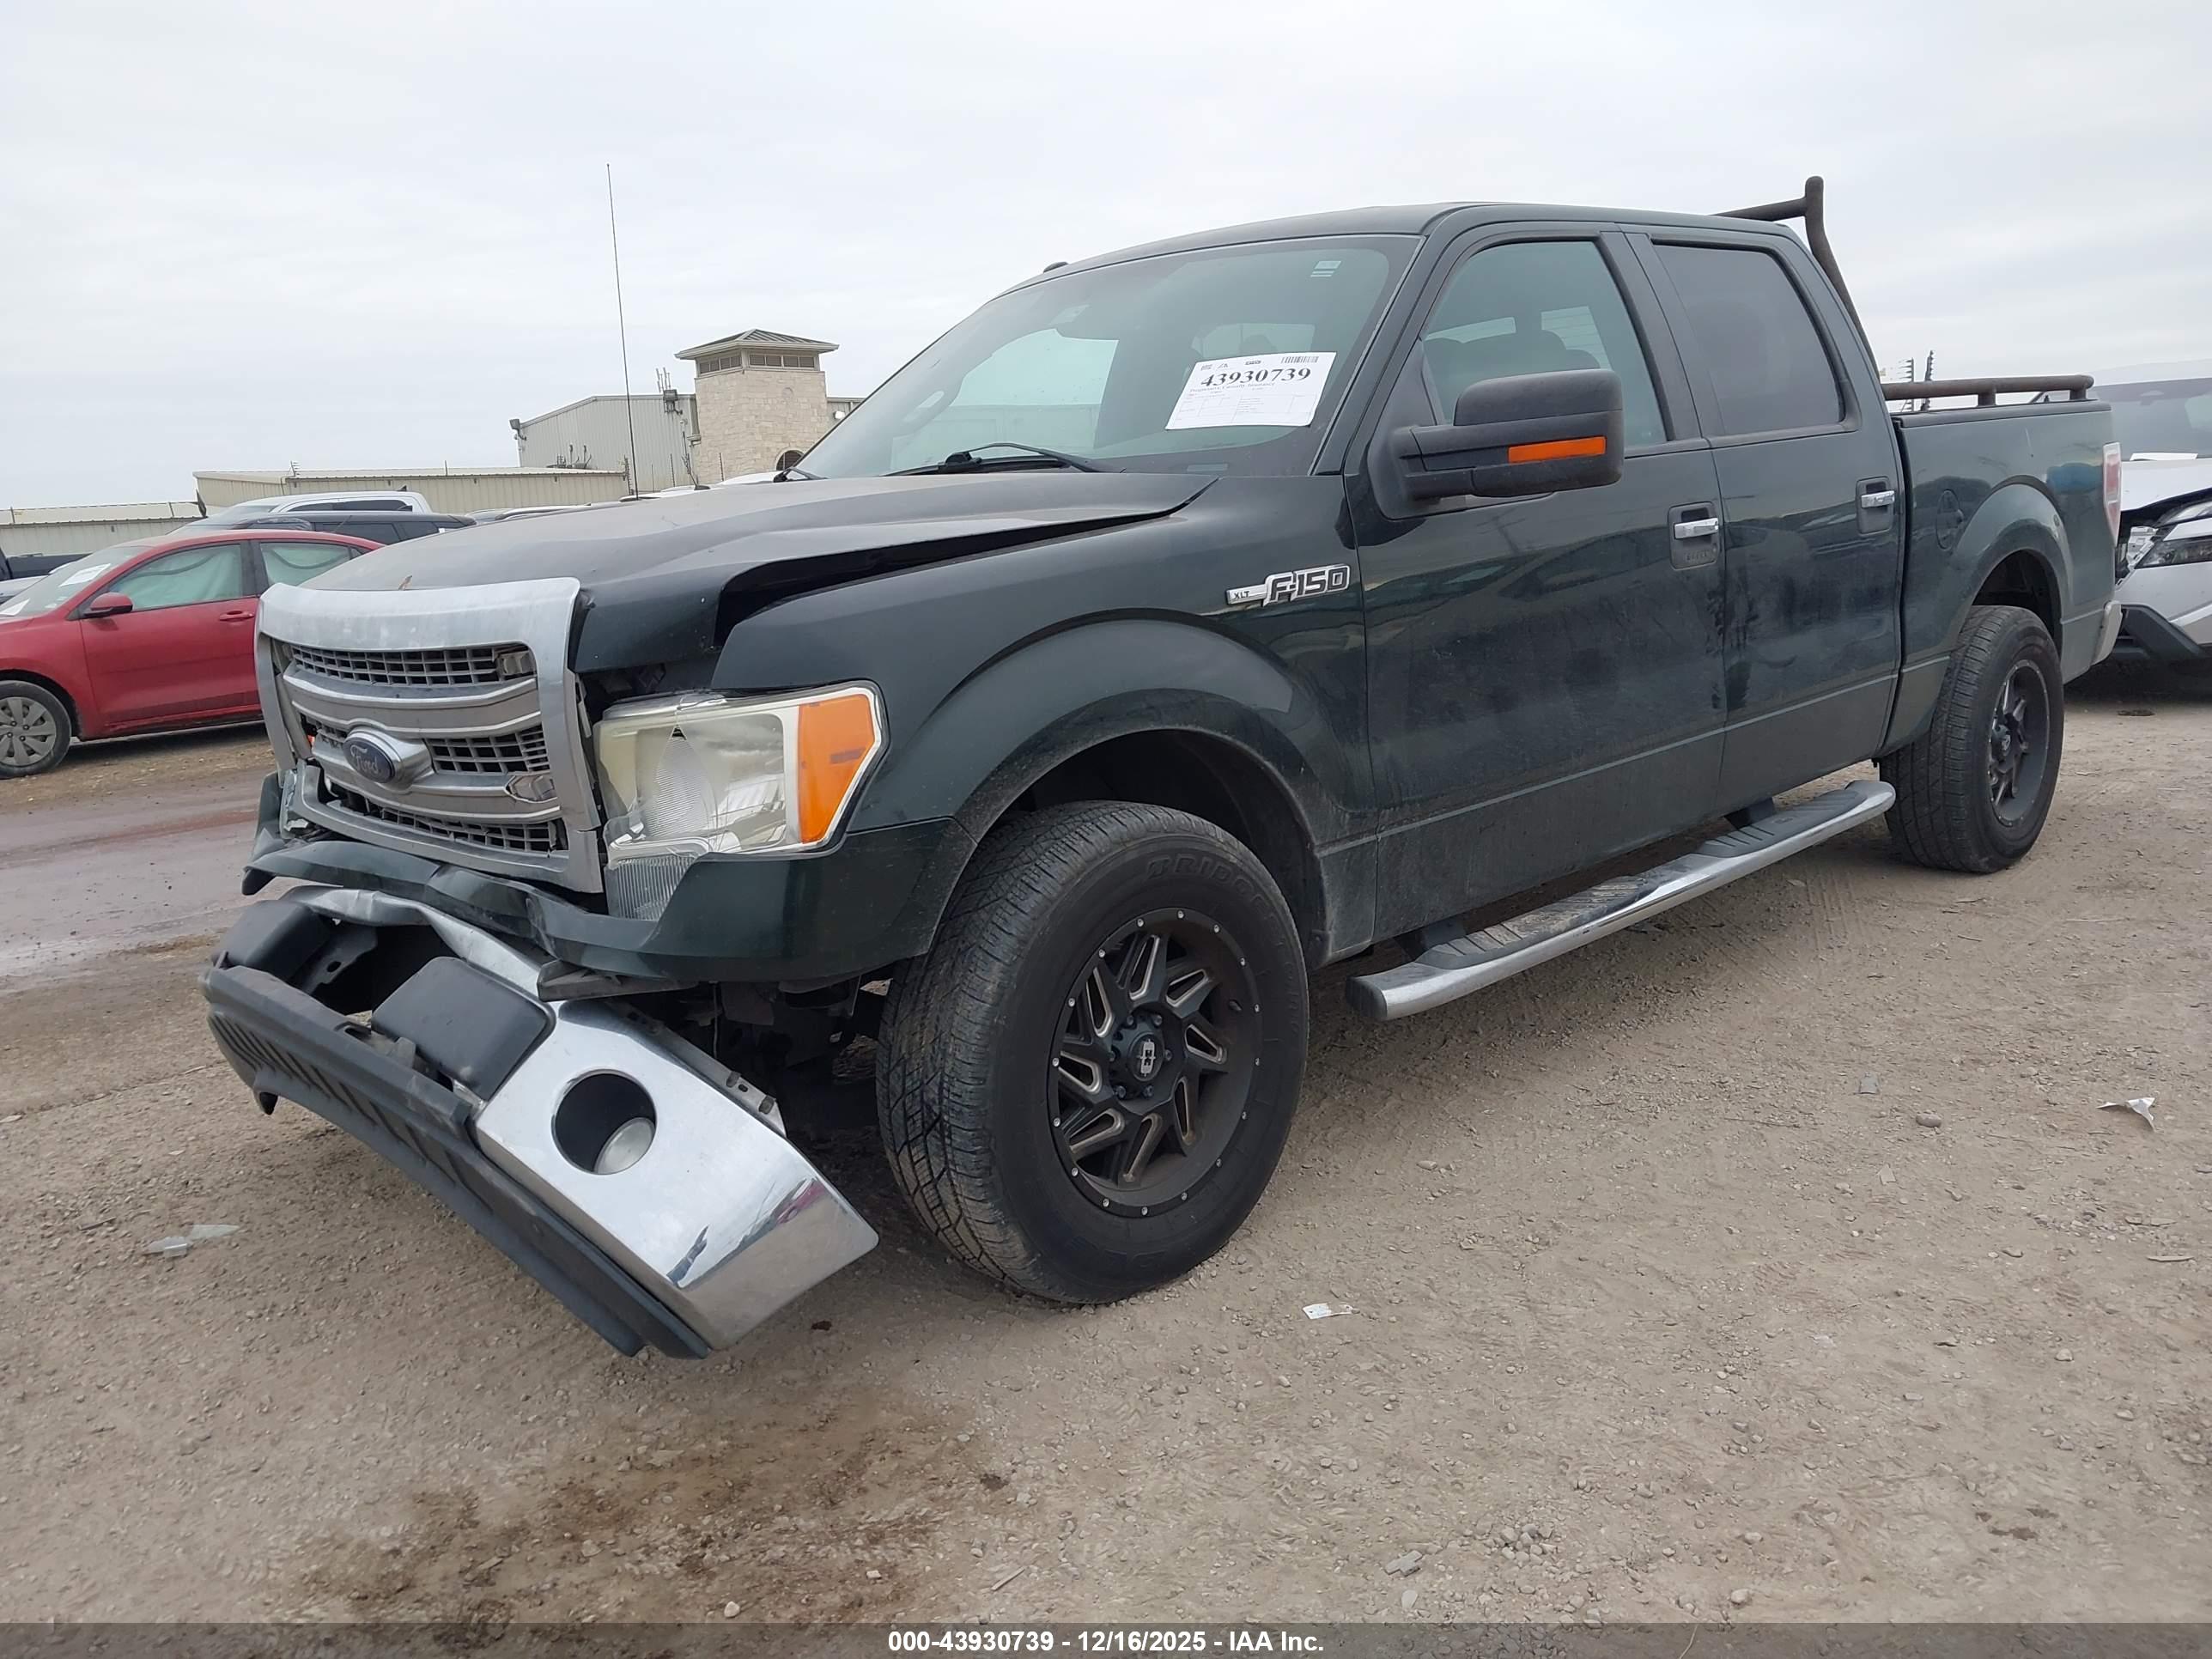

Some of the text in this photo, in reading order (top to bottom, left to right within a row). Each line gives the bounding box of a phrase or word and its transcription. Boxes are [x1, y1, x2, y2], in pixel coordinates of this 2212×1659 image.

[1200, 368, 1311, 386] 43930739
[1233, 564, 1350, 606] XLT F-150
[349, 744, 382, 775] Ford
